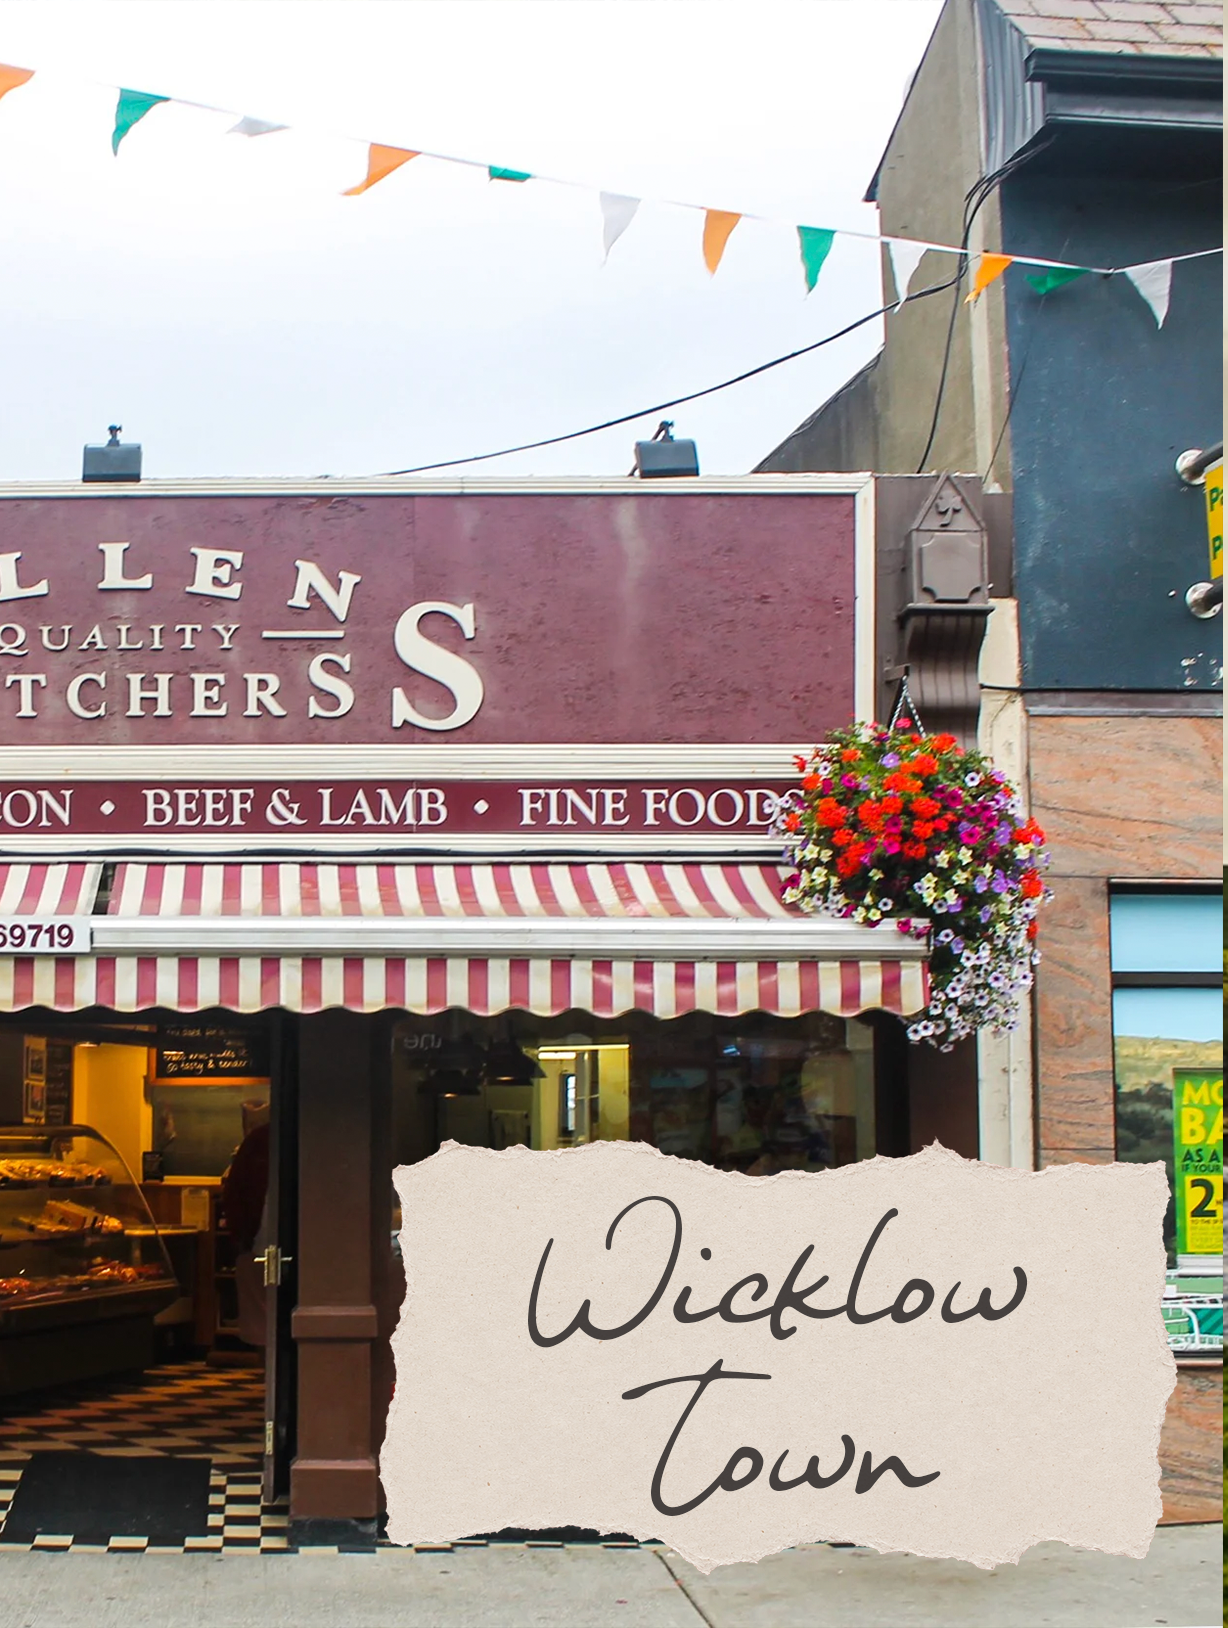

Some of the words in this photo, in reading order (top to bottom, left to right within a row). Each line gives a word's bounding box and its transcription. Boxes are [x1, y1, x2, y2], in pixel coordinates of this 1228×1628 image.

[141, 787, 255, 828] BEEF
[264, 788, 309, 827] &
[318, 787, 449, 828] LAMB
[517, 788, 630, 827] FINE
[1182, 1148, 1203, 1163] AS
